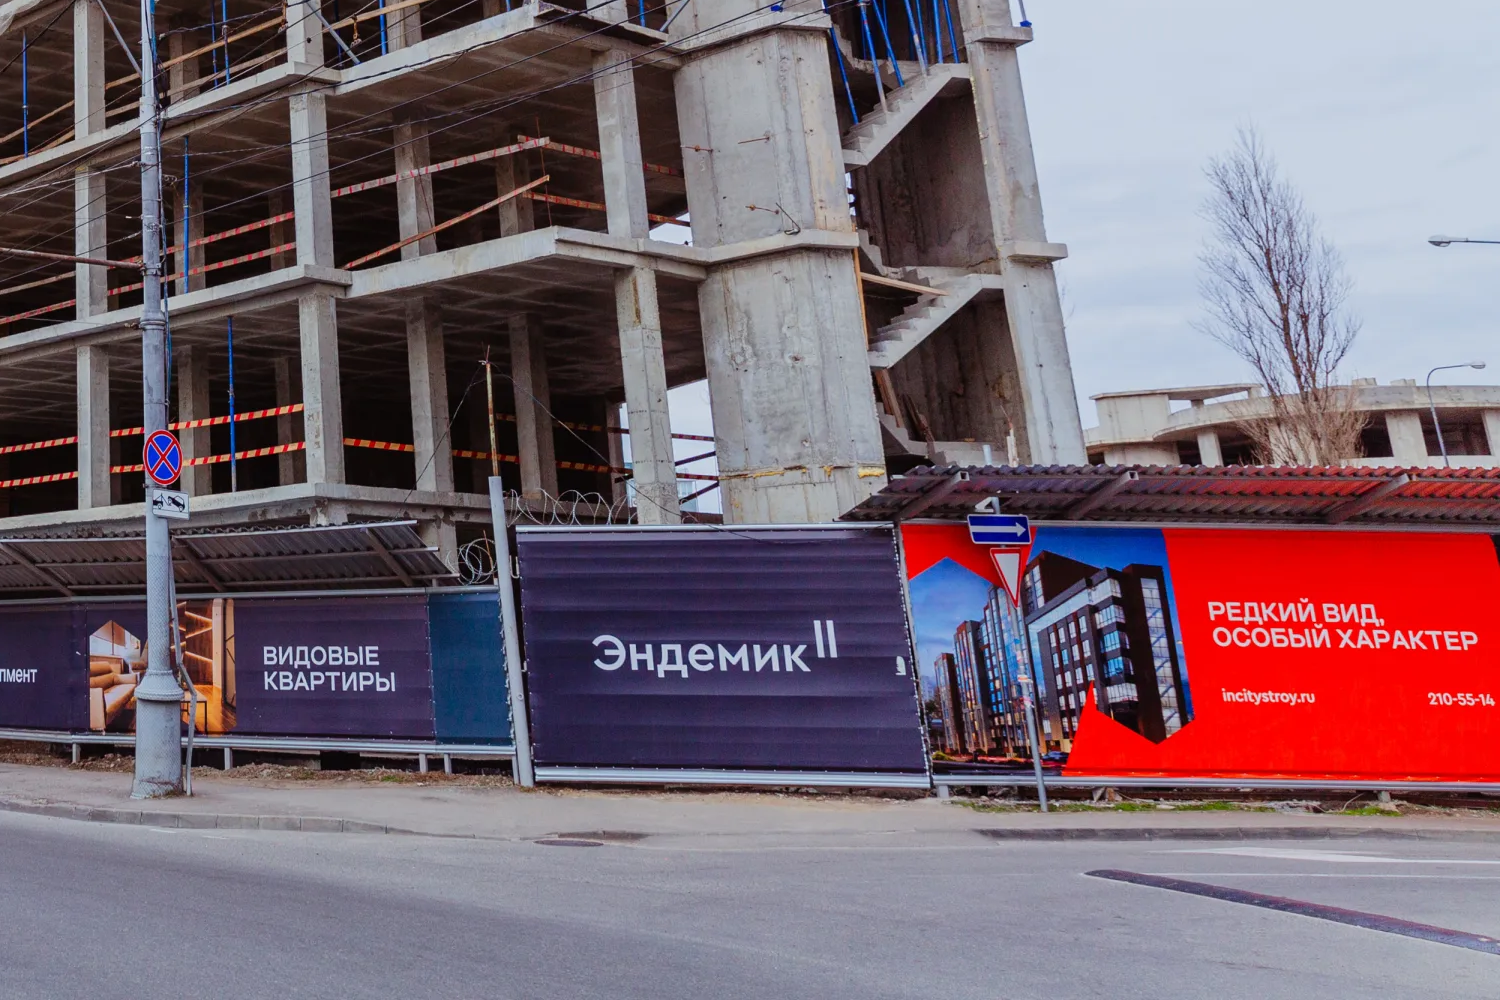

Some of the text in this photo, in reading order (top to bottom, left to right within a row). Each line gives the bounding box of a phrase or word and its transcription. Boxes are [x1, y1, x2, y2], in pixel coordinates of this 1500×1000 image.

[1207, 598, 1385, 627] РЕДКИЙ ВИД,
[1212, 623, 1479, 651] ОСОБЫЙ ХАРАКТЕР
[263, 645, 380, 669] ВИДОВЫЕ
[592, 634, 811, 678] Эндемик
[264, 670, 396, 692] КВАРТИРЫ
[1221, 688, 1316, 706] incitystroy.ru
[1427, 692, 1496, 707] 210-55-14
